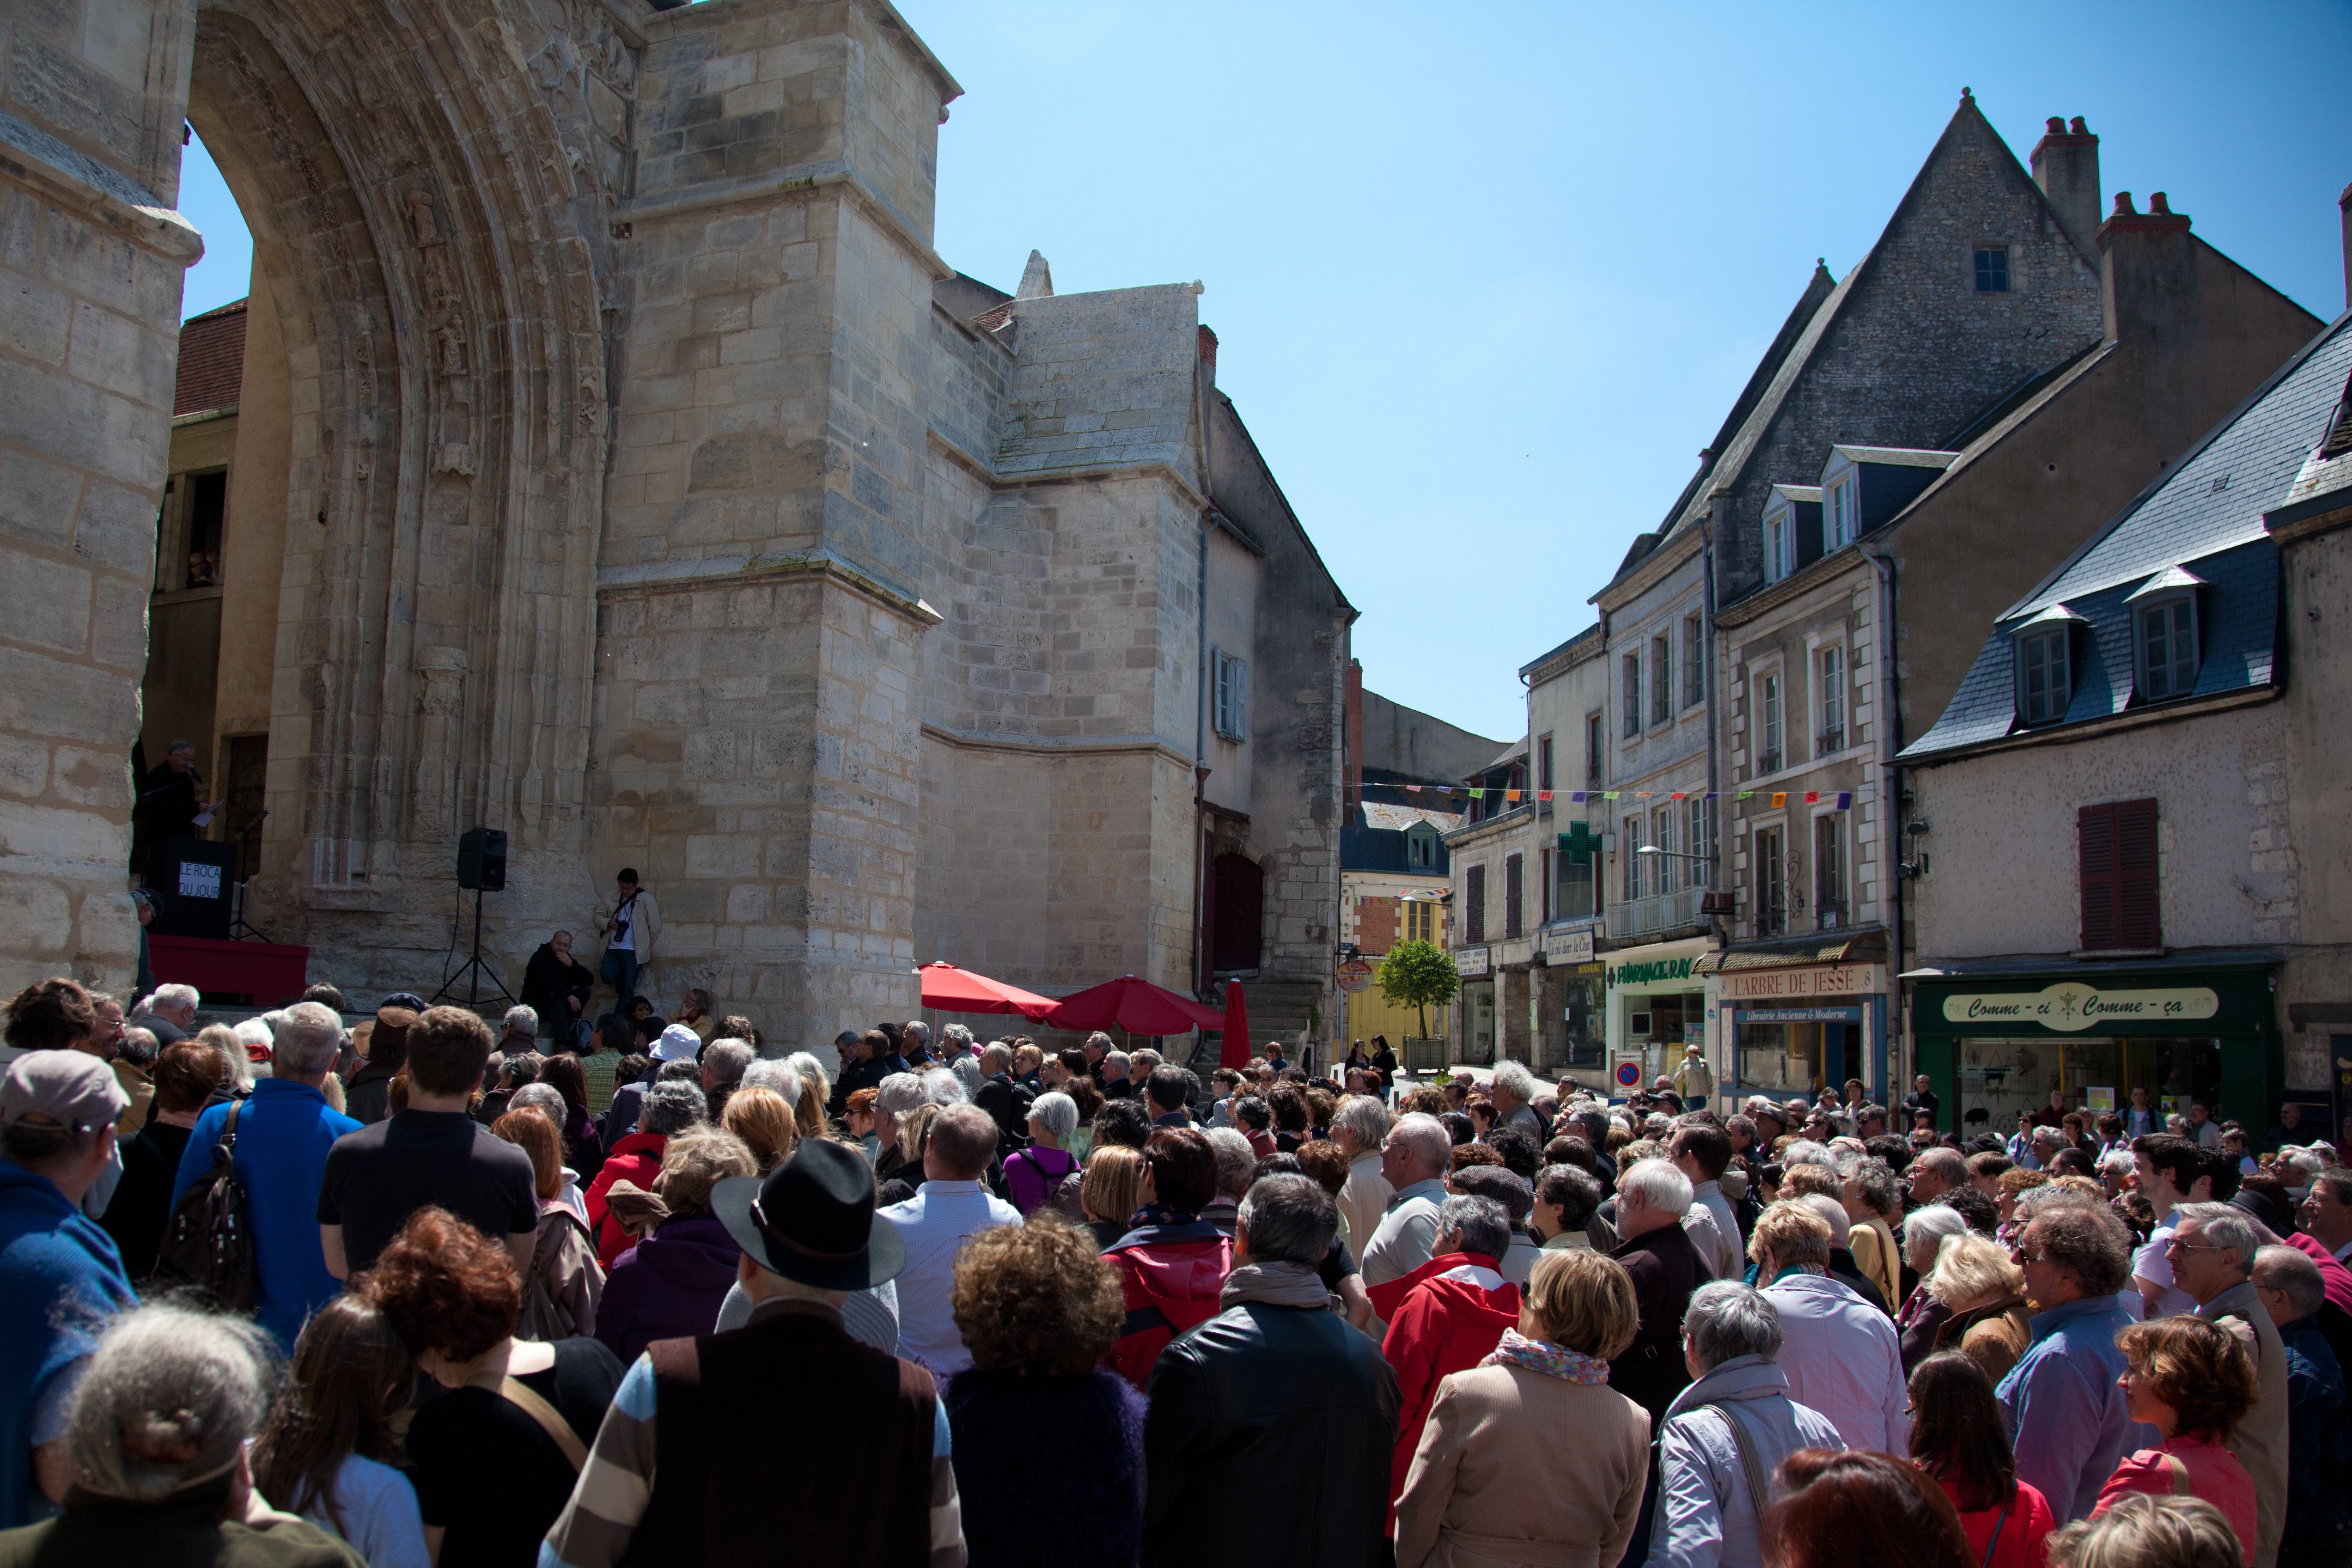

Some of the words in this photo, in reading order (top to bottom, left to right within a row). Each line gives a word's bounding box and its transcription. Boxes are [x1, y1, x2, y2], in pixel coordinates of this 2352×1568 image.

[181, 863, 192, 875] LE
[194, 864, 220, 879] ROCA
[179, 882, 193, 895] DU
[194, 884, 219, 898] JOUR
[1562, 940, 1572, 954] dort
[1573, 938, 1578, 952] le
[1579, 937, 1590, 952] Chat
[1617, 961, 1669, 986] PHARMACIE
[1670, 957, 1692, 980] RAY
[1865, 971, 1871, 986] 8
[1721, 981, 1726, 994] 8
[1735, 975, 1783, 996] L'ARBRE
[1789, 973, 1806, 994] DE
[1812, 966, 1853, 997] JESSÉ
[1968, 998, 2020, 1018] Comme
[2037, 1001, 2051, 1015] ci
[2082, 994, 2143, 1016] Comme
[2163, 1001, 2183, 1016] ça
[1747, 1011, 1775, 1021] Librairie
[1776, 1010, 1806, 1020] Ancienne
[1808, 1010, 1813, 1019] &
[1814, 1009, 1846, 1019] Moderne
